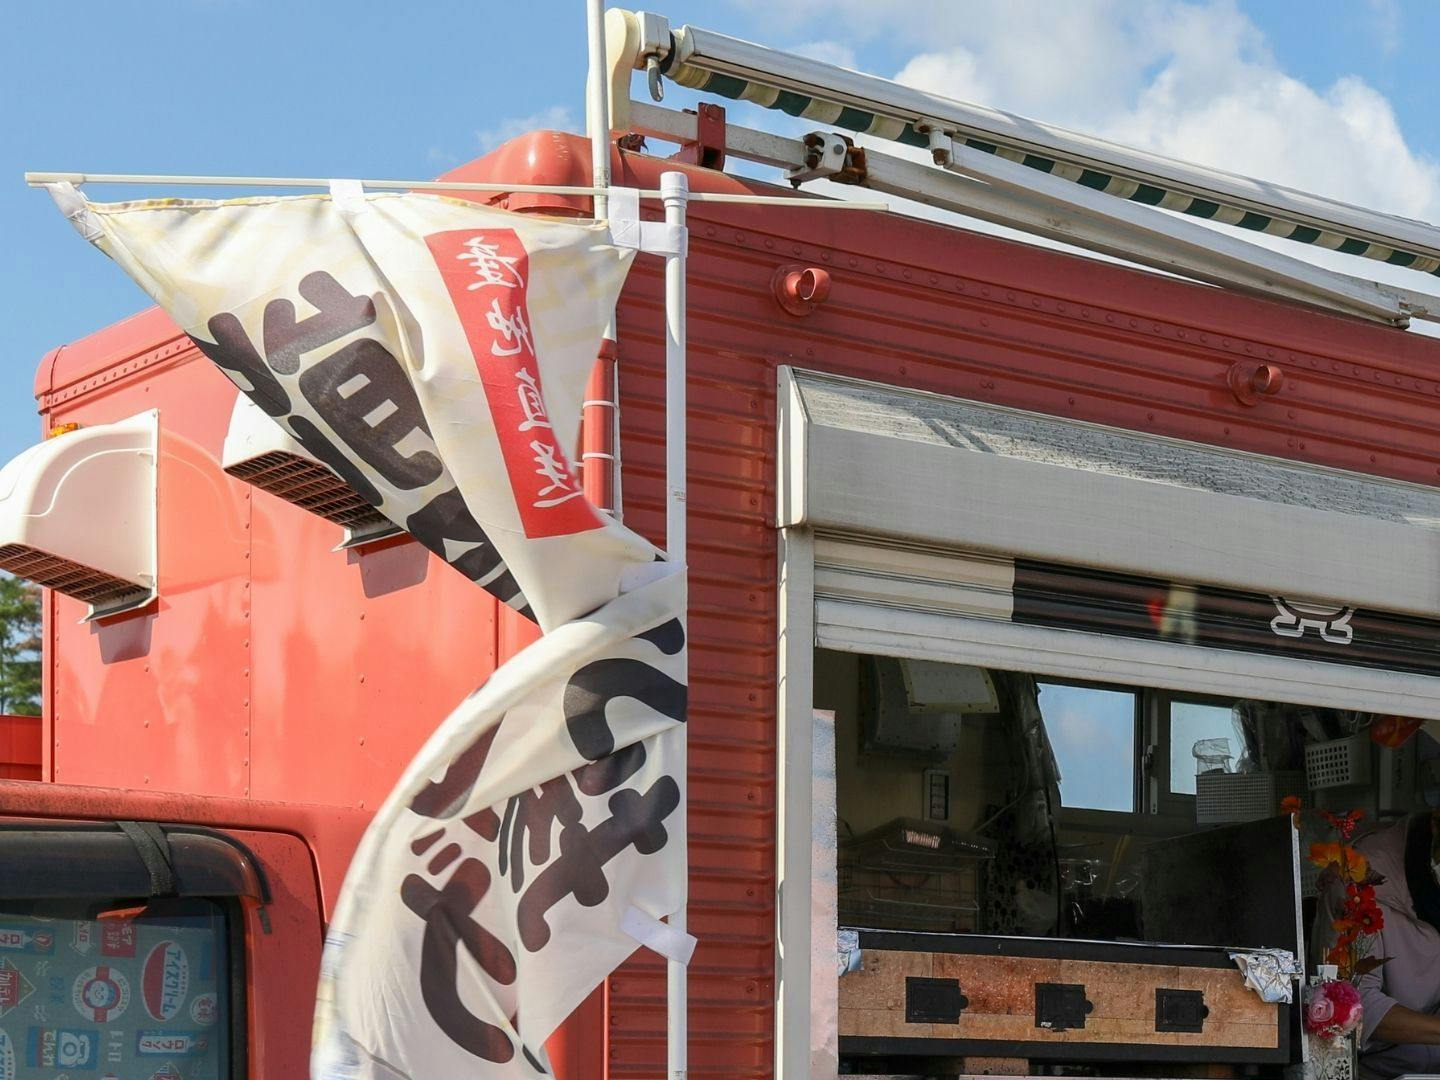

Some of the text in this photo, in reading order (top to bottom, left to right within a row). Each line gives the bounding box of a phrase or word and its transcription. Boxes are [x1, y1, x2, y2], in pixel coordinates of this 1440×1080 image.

[163, 949, 182, 1013] アイスクリーム
